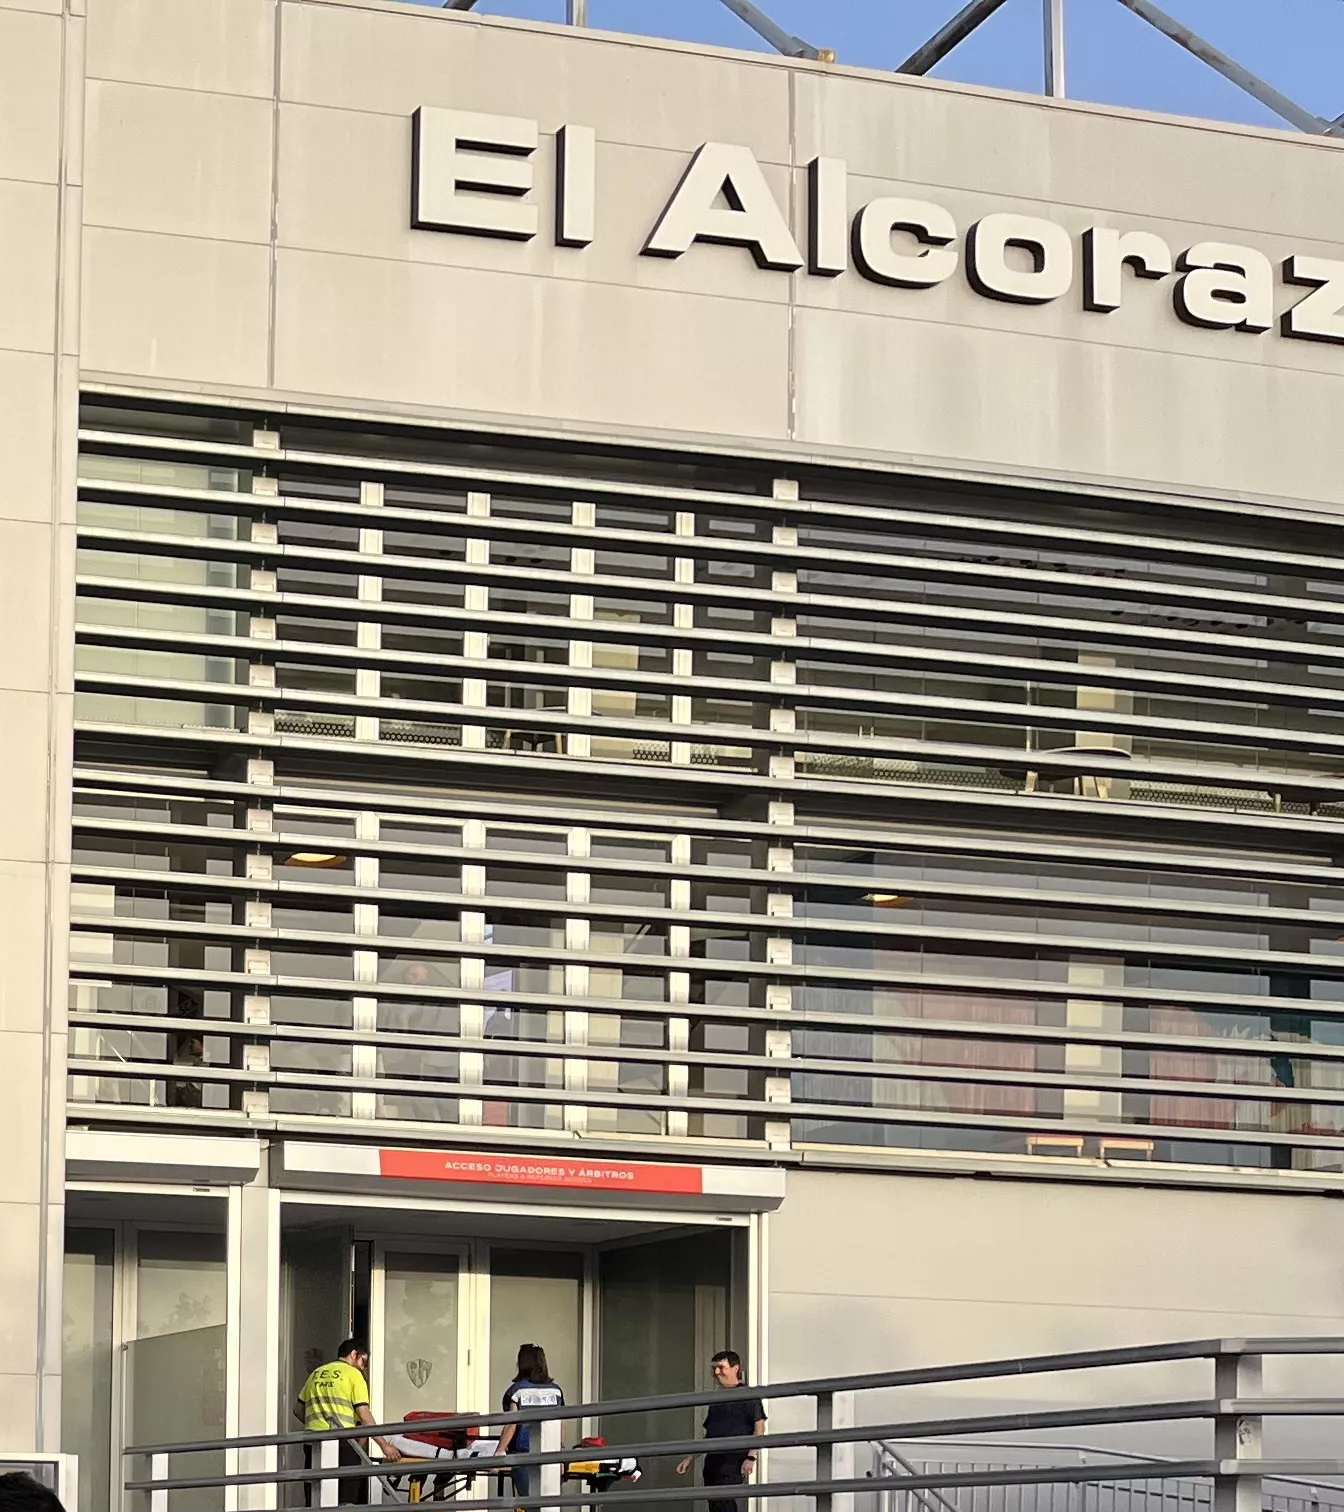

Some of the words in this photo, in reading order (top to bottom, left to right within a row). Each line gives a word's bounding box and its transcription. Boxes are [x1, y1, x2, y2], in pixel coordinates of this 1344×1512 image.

[410, 104, 597, 249] El
[444, 1161, 492, 1172] ACCESO
[495, 1164, 566, 1177] JUGADORES
[579, 1166, 635, 1180] ÁRBITROS
